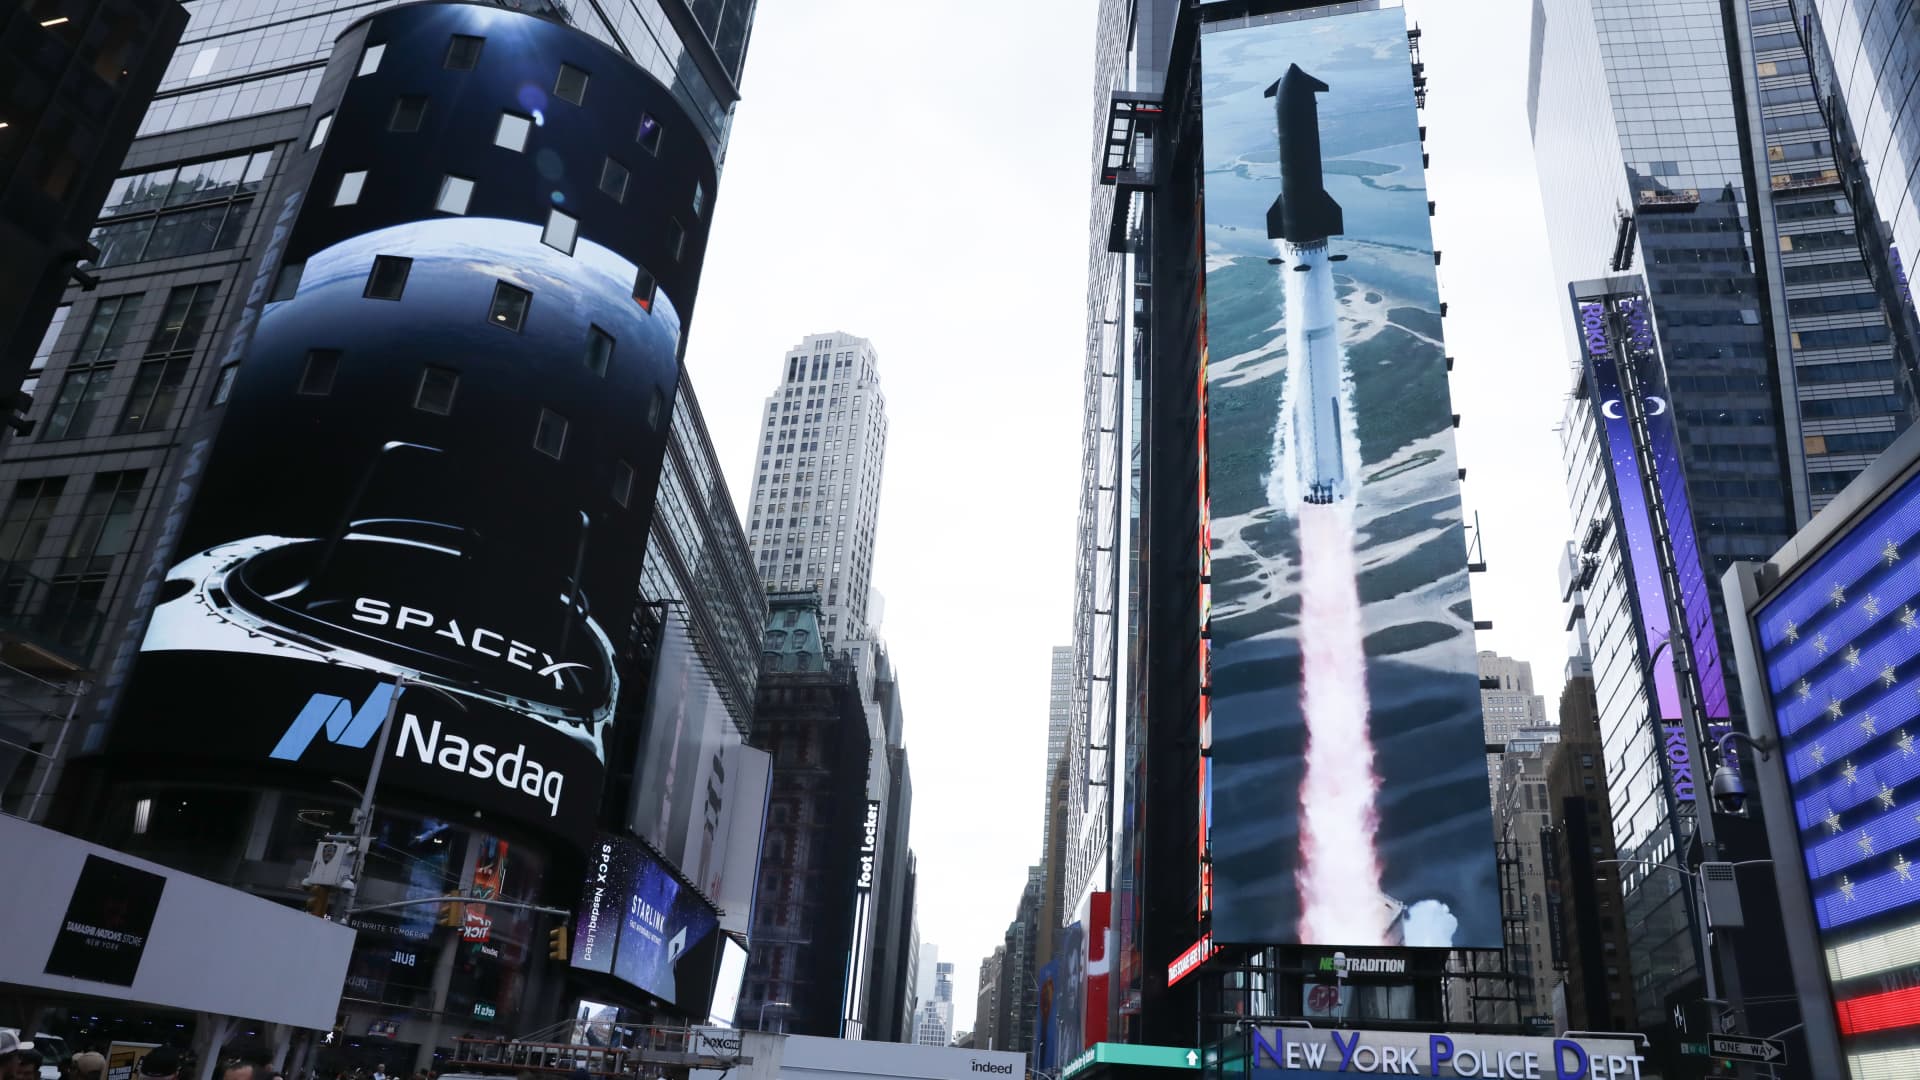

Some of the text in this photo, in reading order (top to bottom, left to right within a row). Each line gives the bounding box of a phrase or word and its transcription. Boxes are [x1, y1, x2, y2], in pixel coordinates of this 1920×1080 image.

[220, 192, 300, 367] NASDAQ
[352, 597, 592, 690] SPACEX
[395, 713, 564, 817] Nasdaq
[597, 844, 611, 884] SPCX
[857, 803, 878, 888] Foot Locker
[631, 894, 666, 934] STARLINK
[85, 938, 119, 951] NEW YORK
[121, 933, 143, 946] STORE
[1346, 958, 1405, 973] TRADITION
[971, 1059, 1013, 1074] indeed
[1252, 1028, 1645, 1080] NEW YORK POLICE DEPT
[1719, 1042, 1773, 1057] ONE WAY
